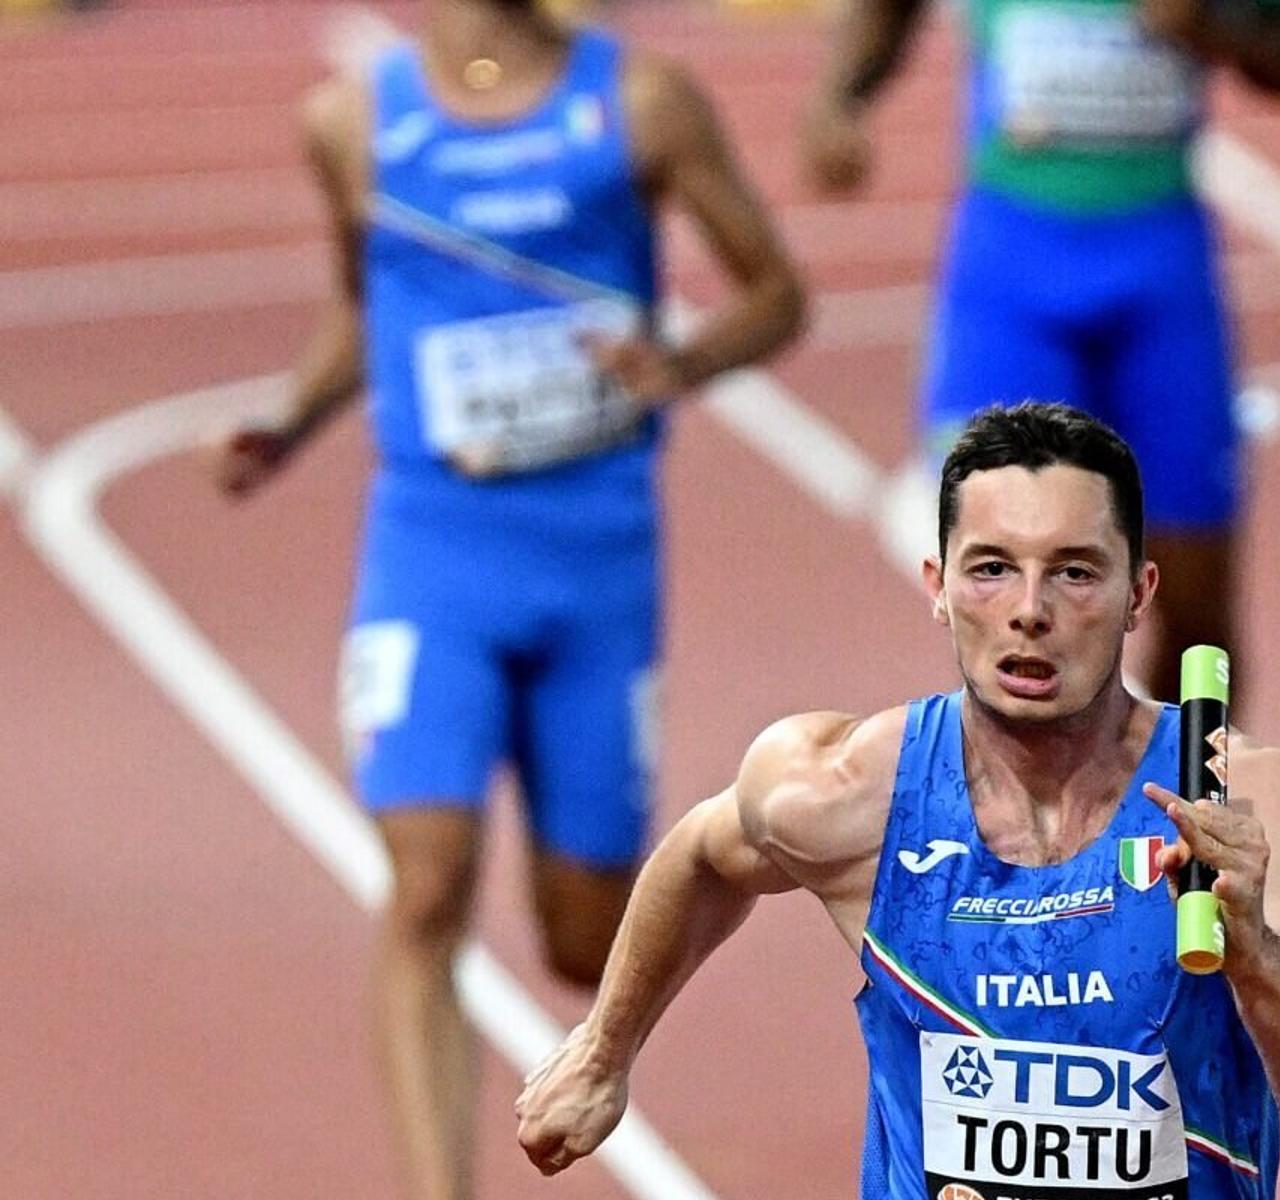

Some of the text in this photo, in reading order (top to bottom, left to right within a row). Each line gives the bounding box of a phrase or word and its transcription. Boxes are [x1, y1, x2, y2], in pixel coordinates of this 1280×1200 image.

[975, 970, 1114, 1008] ITALIA
[994, 1052, 1171, 1111] TDK
[957, 1115, 1153, 1181] TORTU
